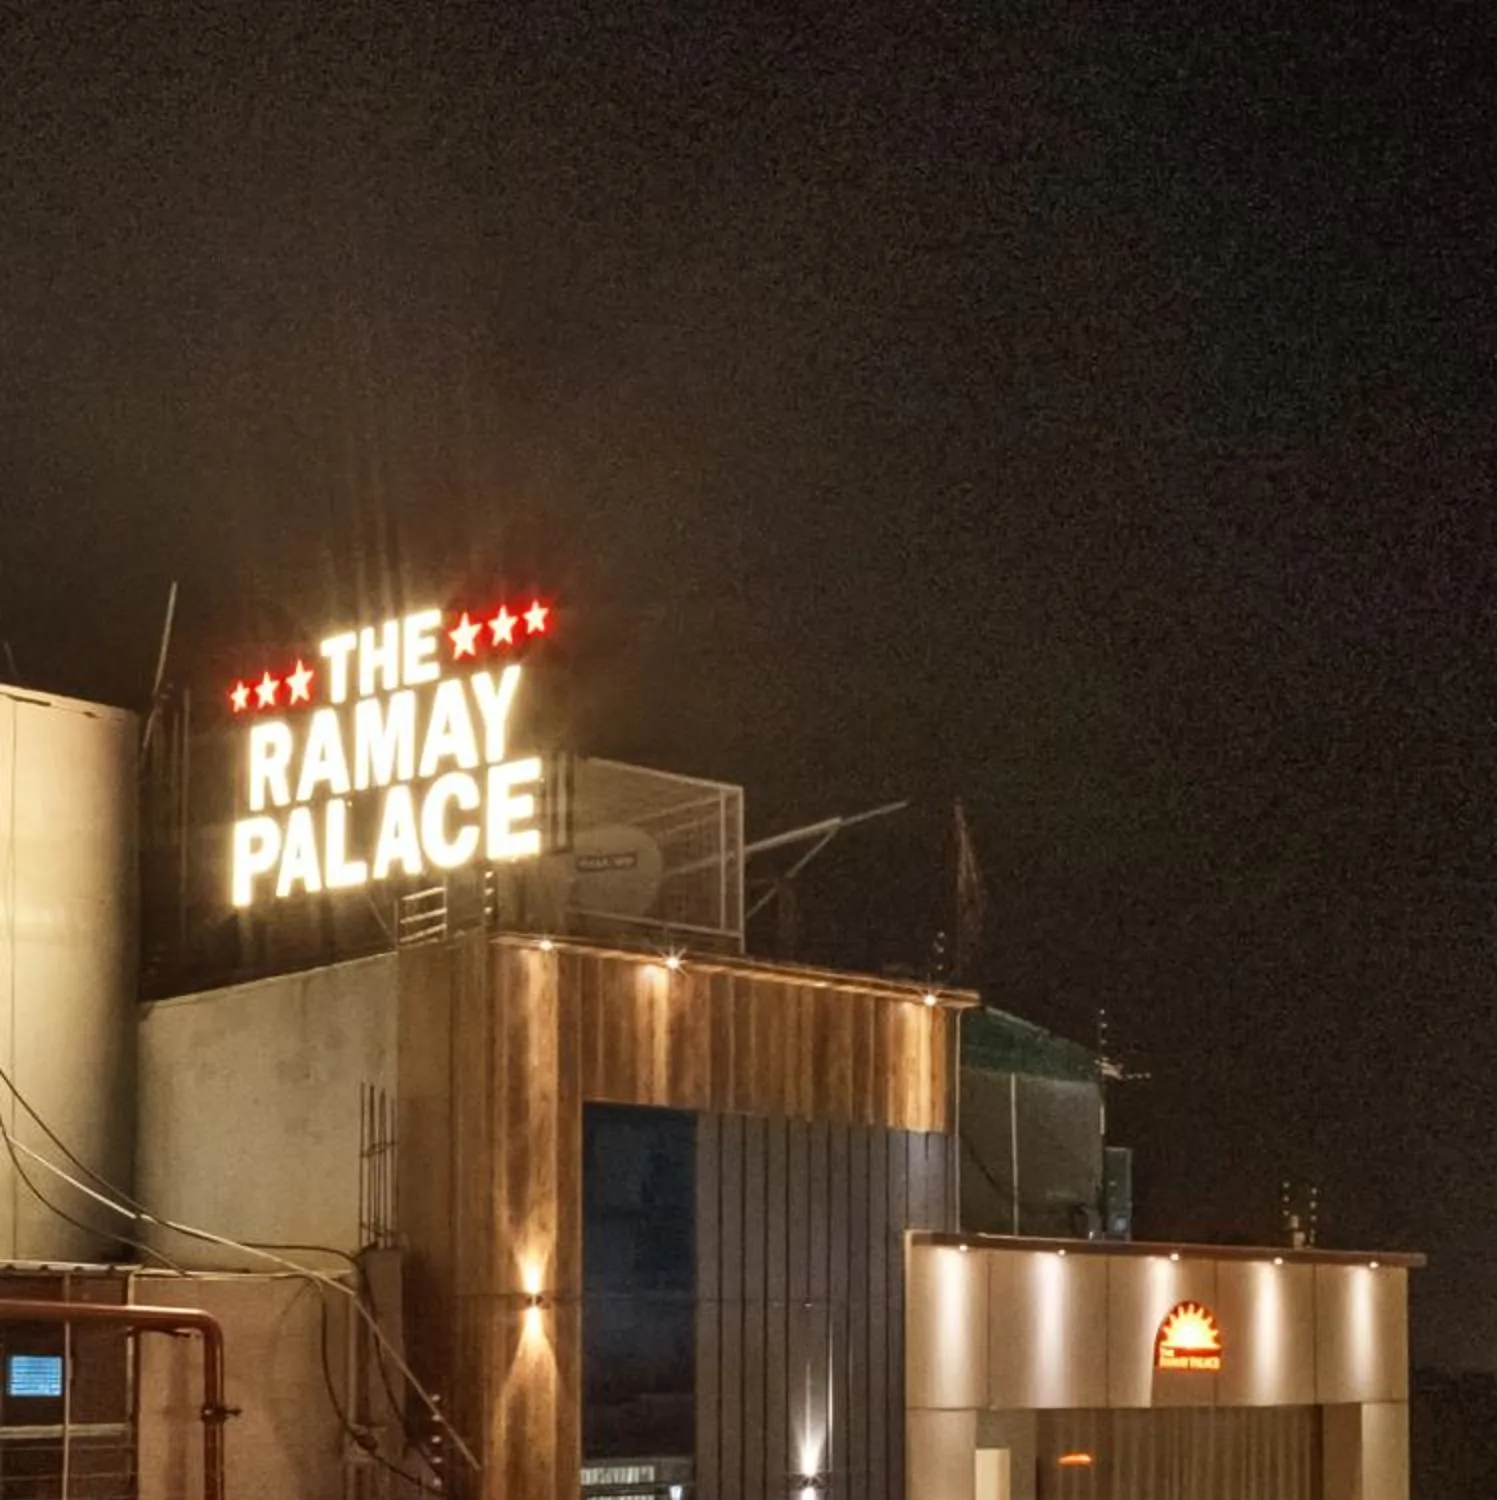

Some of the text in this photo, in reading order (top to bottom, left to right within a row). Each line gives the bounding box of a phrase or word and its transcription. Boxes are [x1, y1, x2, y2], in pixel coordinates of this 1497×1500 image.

[319, 608, 442, 704] THE
[247, 664, 522, 812] RAMAY
[231, 757, 542, 908] PALACE
